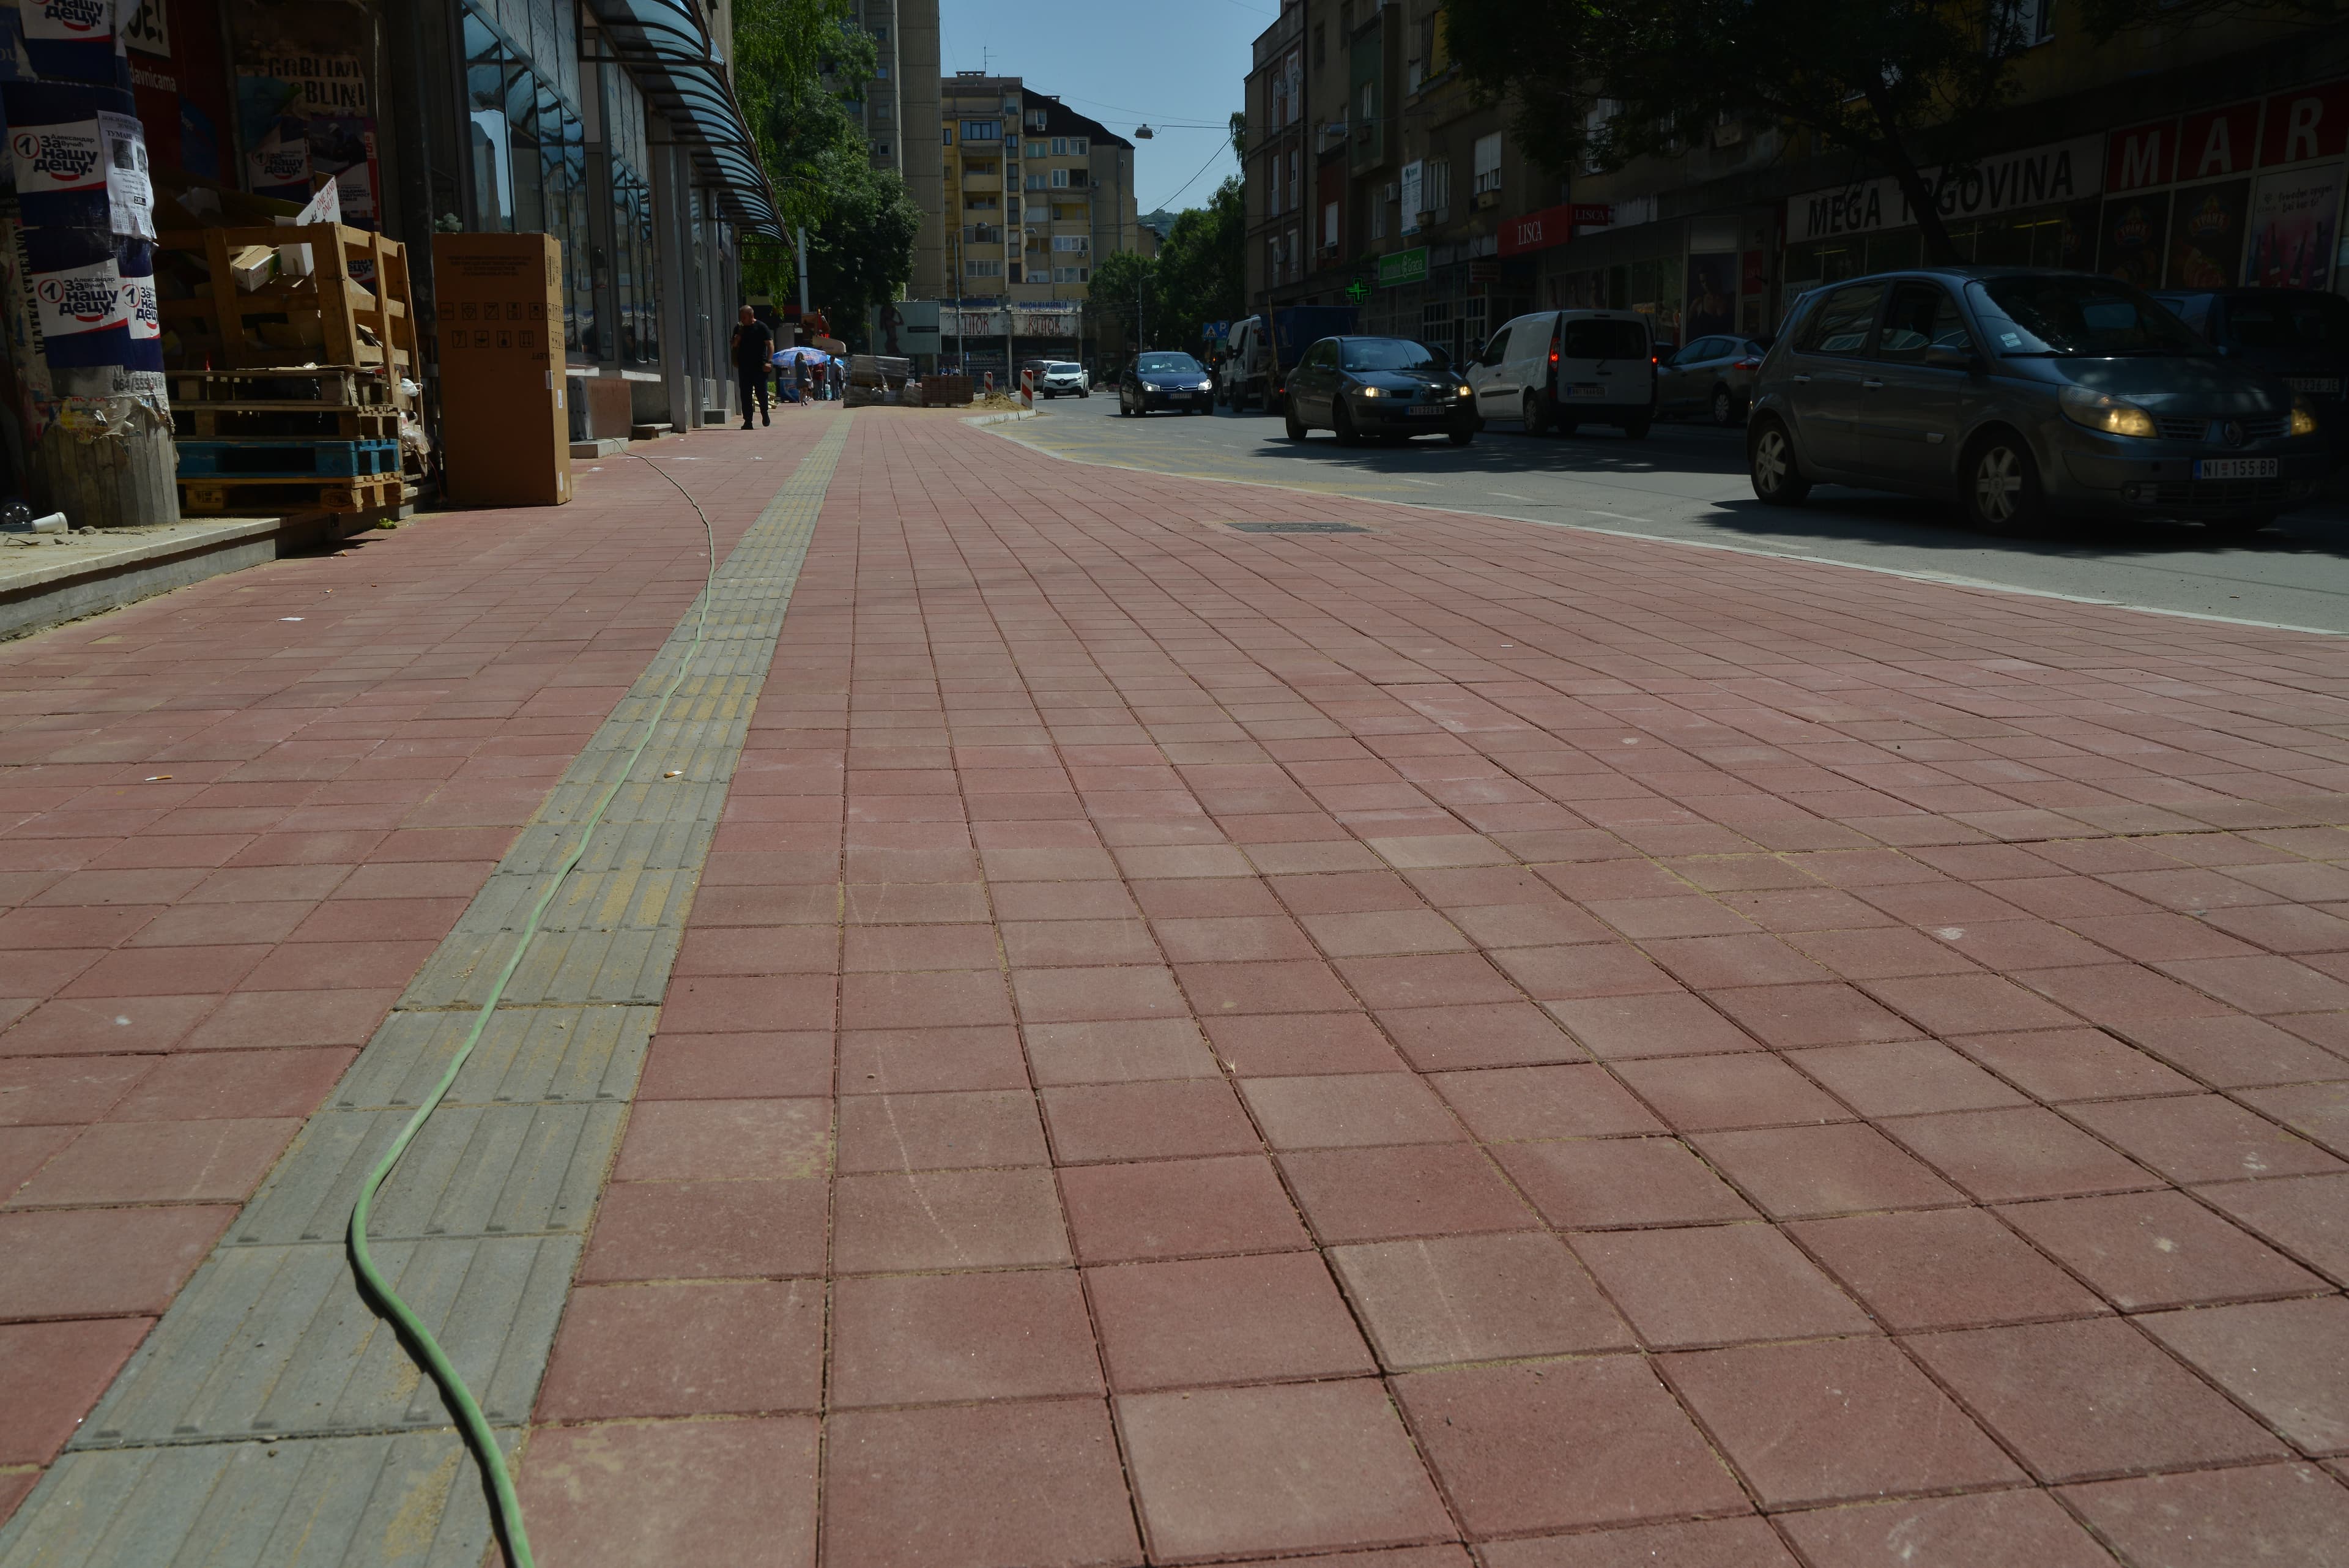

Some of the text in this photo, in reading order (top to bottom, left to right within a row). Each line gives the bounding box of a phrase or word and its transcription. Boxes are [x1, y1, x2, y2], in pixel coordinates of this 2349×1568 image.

[44, 6, 102, 27] децу.
[40, 136, 61, 148] За
[51, 133, 95, 143] Александар
[42, 149, 98, 165] нашу
[269, 158, 303, 168] нашу
[34, 159, 93, 176] децу.
[264, 165, 300, 176] децу.
[316, 180, 336, 210] ONE AND
[1807, 150, 2074, 237] MEGA GOVINA
[322, 198, 335, 217] ONLY!
[1575, 209, 1605, 220] LISCA
[1518, 220, 1542, 245] LISCA
[64, 280, 84, 291] За
[65, 291, 119, 303] нашу
[59, 300, 116, 316] децу.
[1219, 322, 1226, 332] P
[2203, 461, 2218, 477] NI
